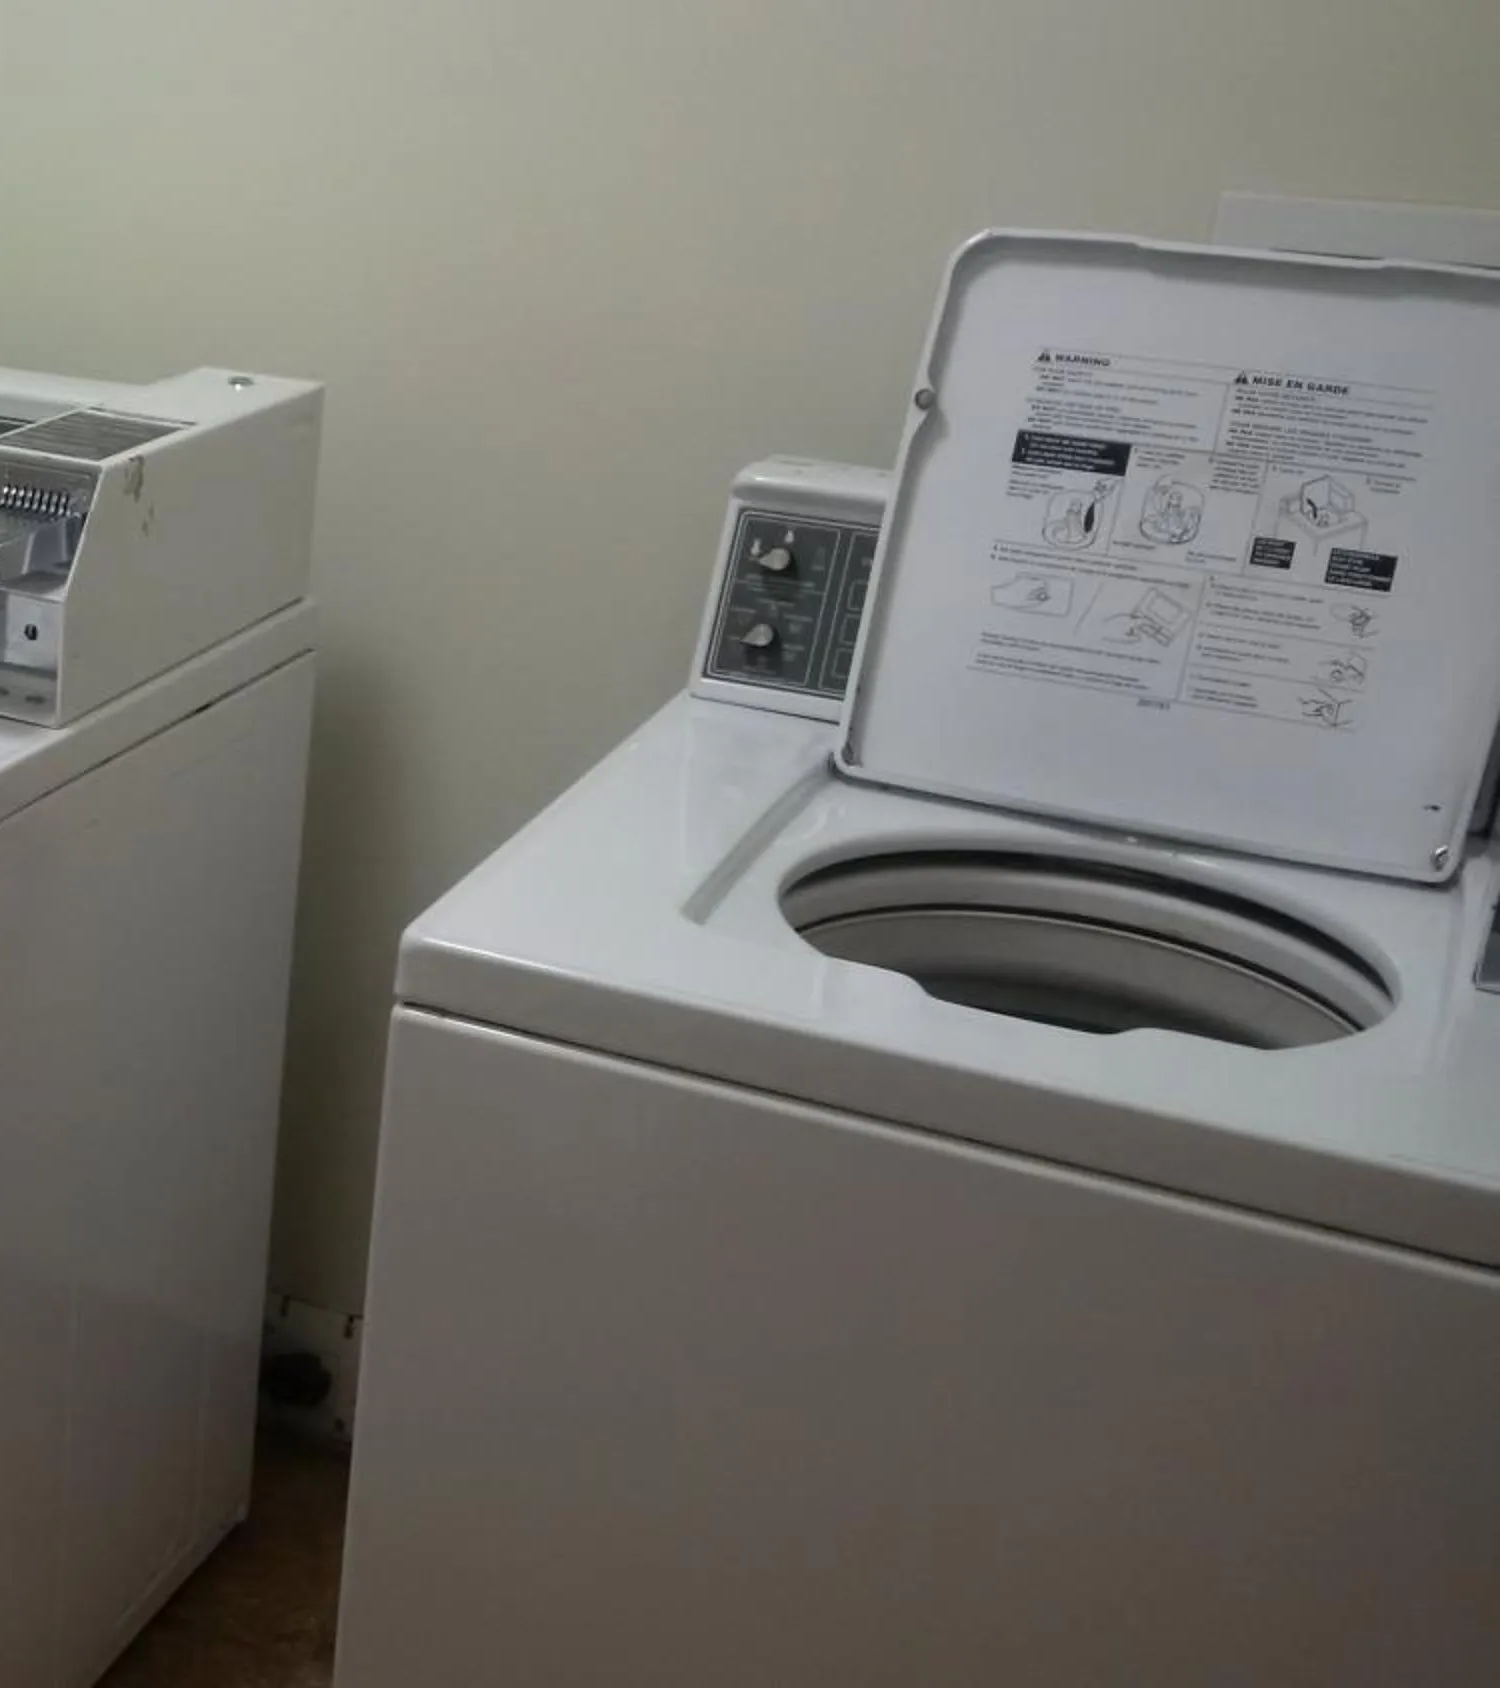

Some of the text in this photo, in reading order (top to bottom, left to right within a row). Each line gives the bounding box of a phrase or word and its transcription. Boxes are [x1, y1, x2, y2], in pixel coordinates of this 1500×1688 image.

[1055, 353, 1111, 367] WARNING
[1252, 374, 1283, 388] MISE
[1286, 379, 1304, 390] EN
